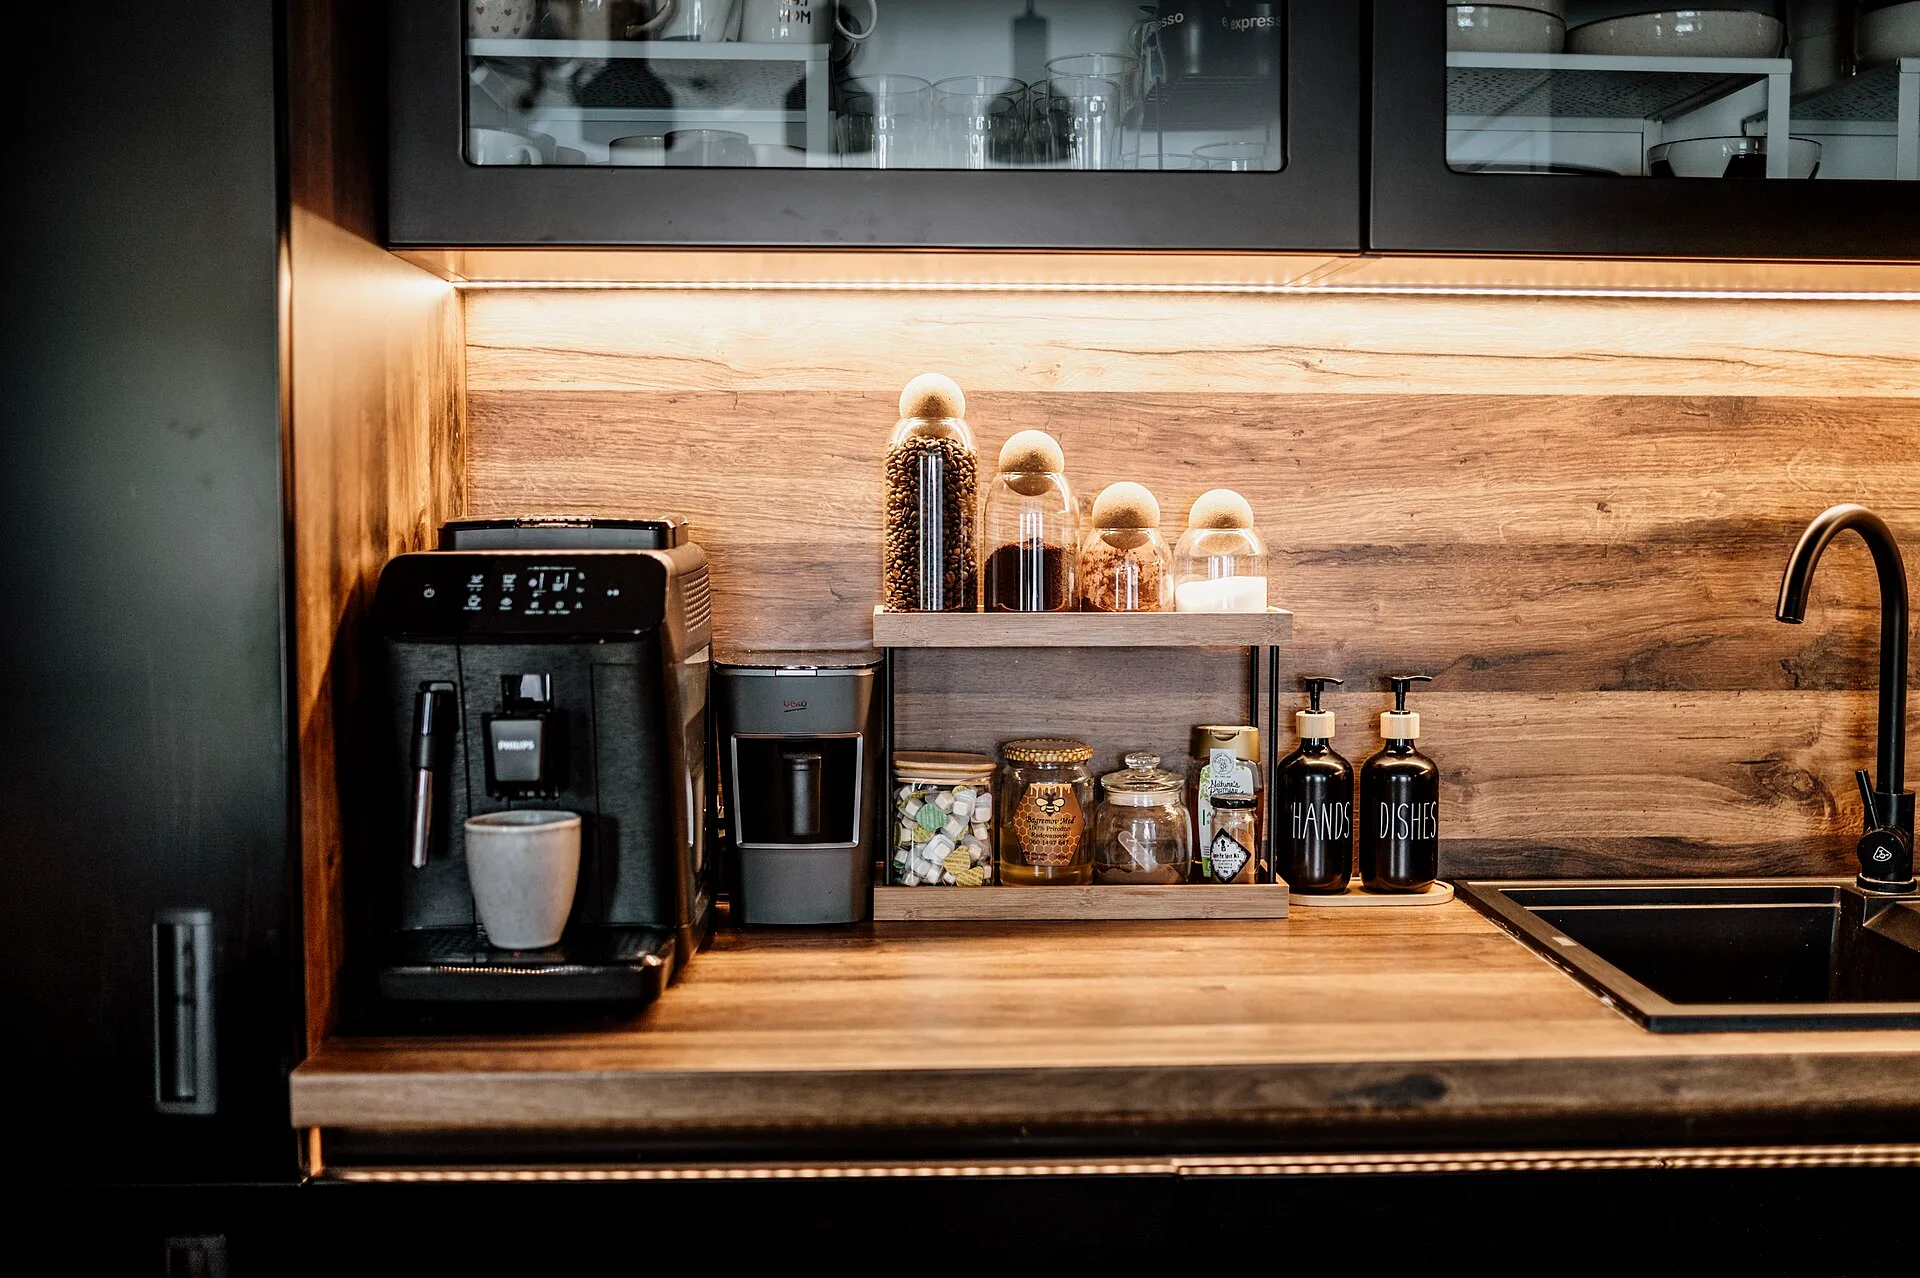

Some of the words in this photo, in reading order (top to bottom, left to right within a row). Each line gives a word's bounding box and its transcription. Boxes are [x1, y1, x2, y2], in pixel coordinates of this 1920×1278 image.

[779, 9, 811, 24] MOM
[497, 739, 536, 751] PHILIPS
[1210, 779, 1241, 789] Nature's
[1292, 802, 1350, 840] HANDS
[1380, 801, 1437, 840] DISHES
